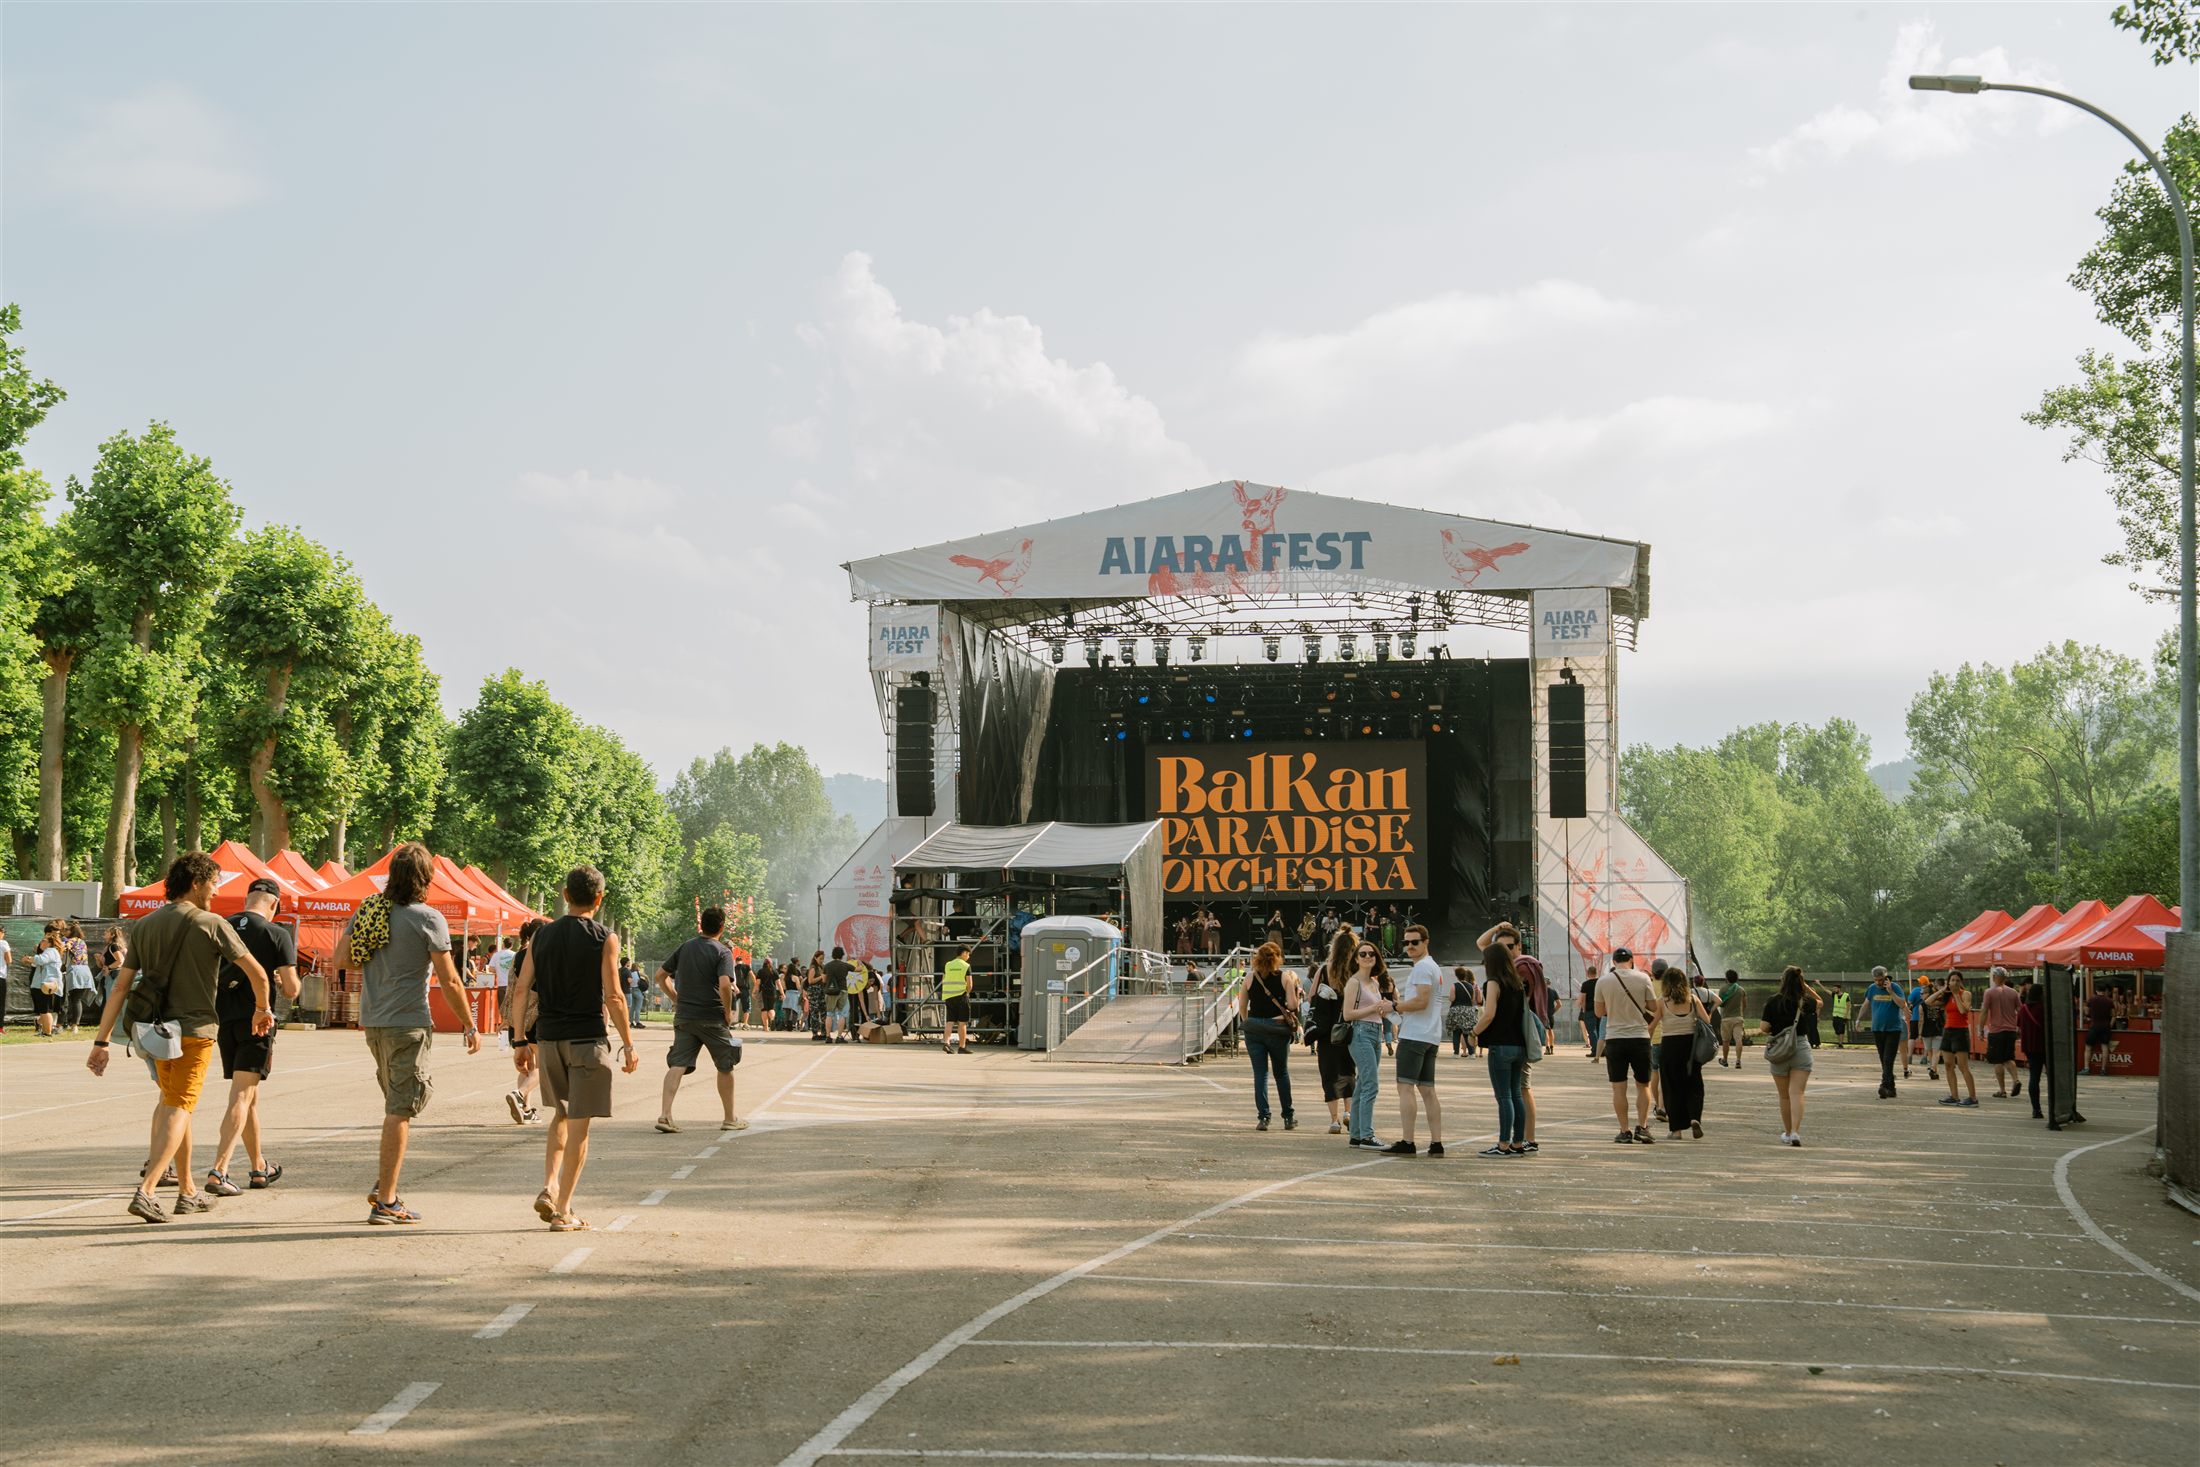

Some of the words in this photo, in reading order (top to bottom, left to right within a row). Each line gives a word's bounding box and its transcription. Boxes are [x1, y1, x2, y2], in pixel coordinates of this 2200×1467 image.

[1099, 534, 1248, 575] AIARA
[1261, 531, 1373, 572] FEST
[1543, 609, 1598, 625] AIARA
[879, 626, 931, 641] AIARA
[1551, 625, 1592, 640] FEST
[887, 640, 924, 654] FEST
[313, 901, 351, 911] AMBAR
[2096, 951, 2135, 961] AMBAR
